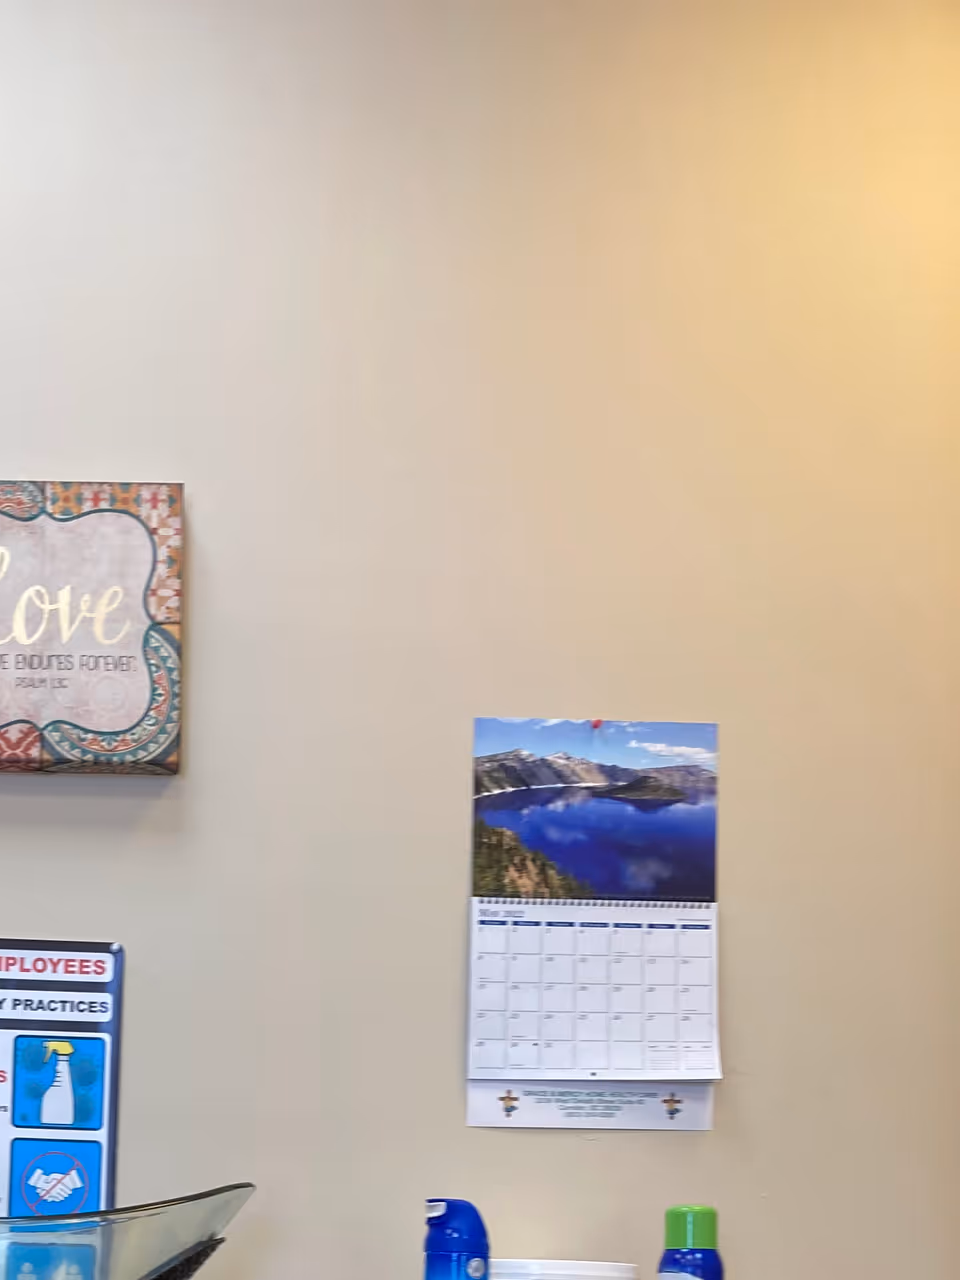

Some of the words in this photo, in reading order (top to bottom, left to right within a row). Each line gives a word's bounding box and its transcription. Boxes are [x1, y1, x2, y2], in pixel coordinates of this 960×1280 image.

[14, 654, 74, 670] ENDURES
[15, 677, 47, 688] PSALM
[10, 998, 109, 1013] PRACTICES
